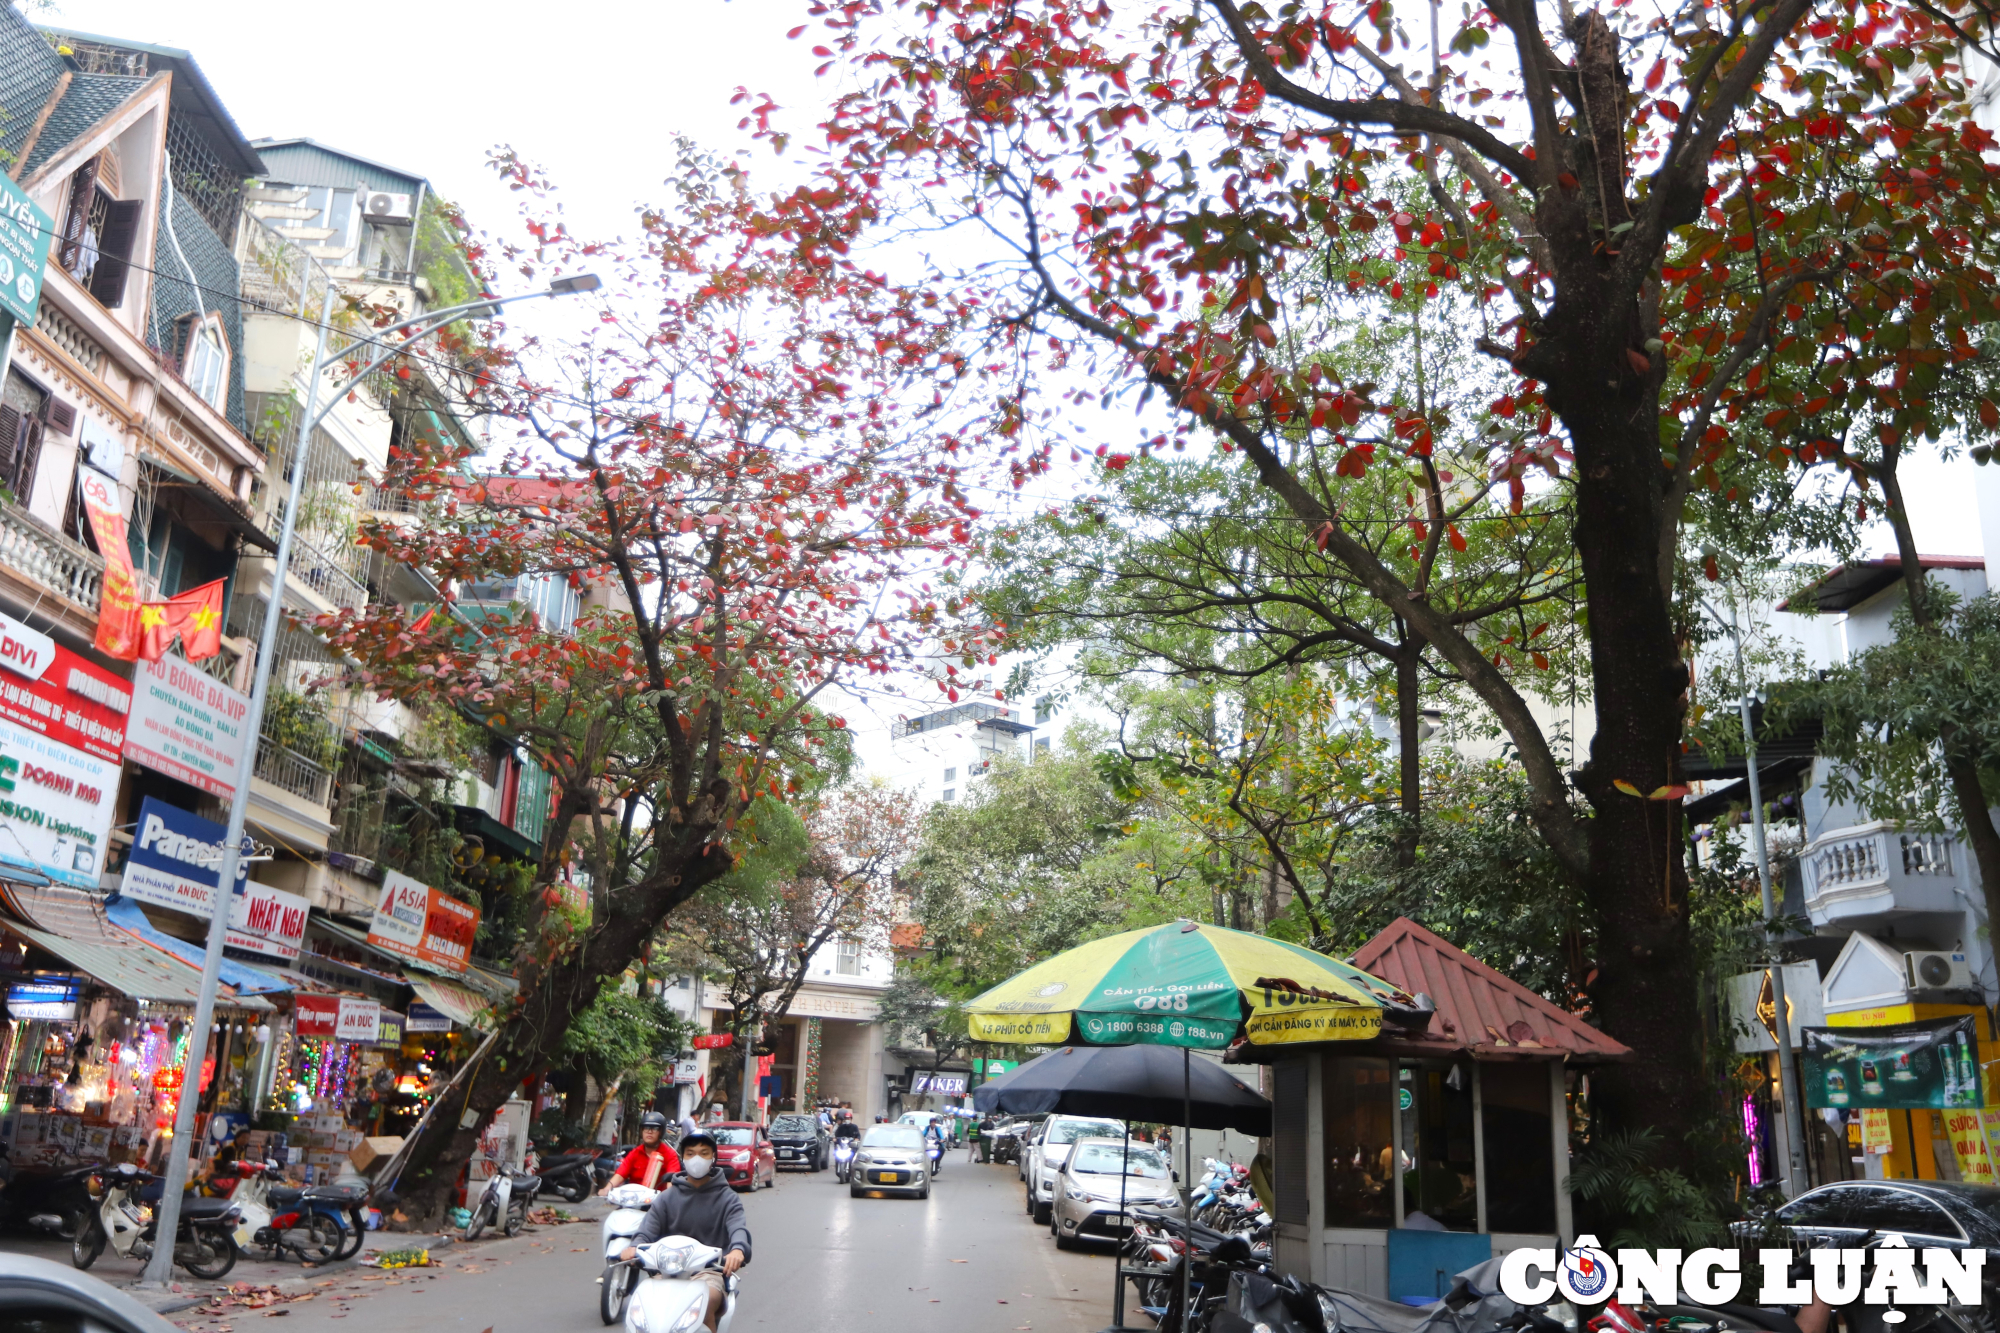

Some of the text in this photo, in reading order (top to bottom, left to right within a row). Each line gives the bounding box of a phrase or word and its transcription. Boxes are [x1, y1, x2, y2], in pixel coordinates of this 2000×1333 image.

[169, 665, 206, 702] BÓNG
[207, 686, 246, 722] ĐÁ.VIP
[150, 685, 177, 707] CHUYÊN
[179, 701, 193, 715] BÁN
[194, 708, 212, 724] BUÔN
[217, 720, 230, 734] BÁN
[175, 715, 214, 742] ÁO BÓNG ĐÁ
[13, 733, 36, 750] THIẾT
[36, 743, 47, 757] BỊ
[47, 745, 67, 765] ĐIỆN
[69, 754, 87, 770] CAO
[21, 762, 74, 797] DOANH
[140, 813, 248, 880] Panasoc
[177, 884, 190, 896] AN
[191, 886, 209, 902] ĐỨC
[397, 887, 427, 912] ASIA
[279, 905, 305, 939] NGA
[1103, 986, 1133, 996] CẦN
[1167, 984, 1193, 993] GỌI
[814, 999, 857, 1014] HOTEL
[995, 1000, 1056, 1011] SIÊU NHANH
[344, 1011, 374, 1028] AN ĐỨC
[995, 1022, 1016, 1035] PHÚT
[1106, 1021, 1224, 1040] 1800 6388 f88.vn
[1284, 1017, 1312, 1030] ĐĂNG
[1314, 1015, 1325, 1028] KÝ
[1328, 1018, 1337, 1028] XE
[1338, 1015, 1358, 1029] MÁY,
[1360, 1015, 1367, 1027] Ô
[1370, 1015, 1382, 1028] TÔ
